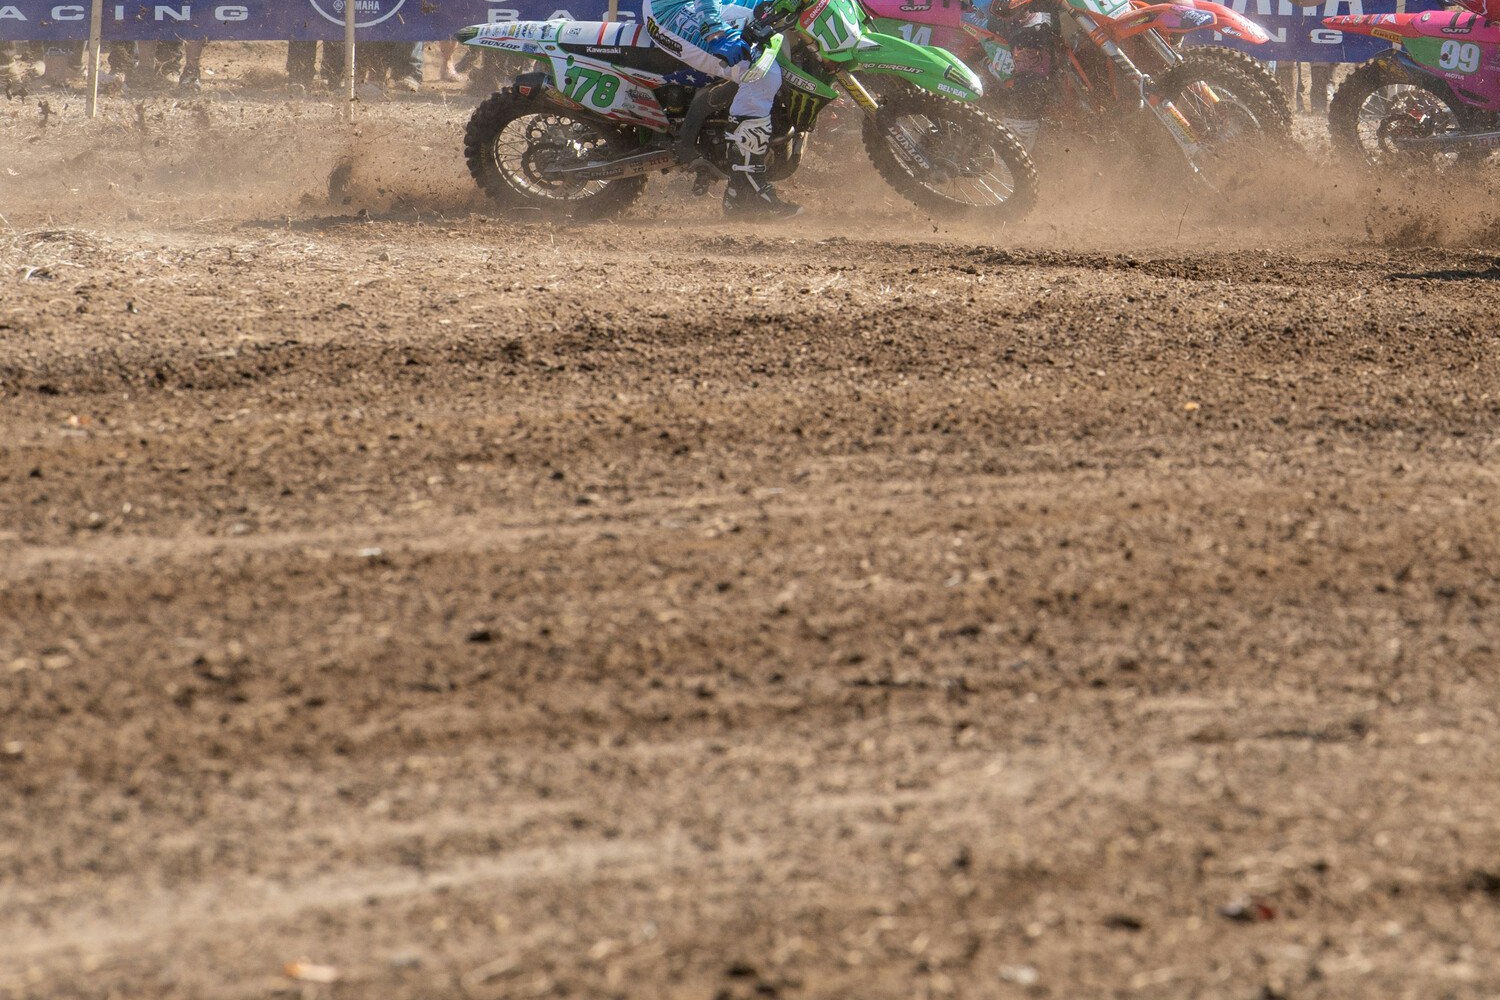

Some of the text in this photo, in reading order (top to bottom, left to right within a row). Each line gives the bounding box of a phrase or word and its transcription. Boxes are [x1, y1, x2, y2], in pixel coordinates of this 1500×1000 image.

[480, 40, 520, 51] DUNLOP
[587, 46, 622, 54] Kawasaki
[1438, 40, 1480, 73] 99
[878, 63, 924, 75] CIRCUIT
[564, 66, 620, 108] 178
[886, 126, 930, 170] DUNLOP
